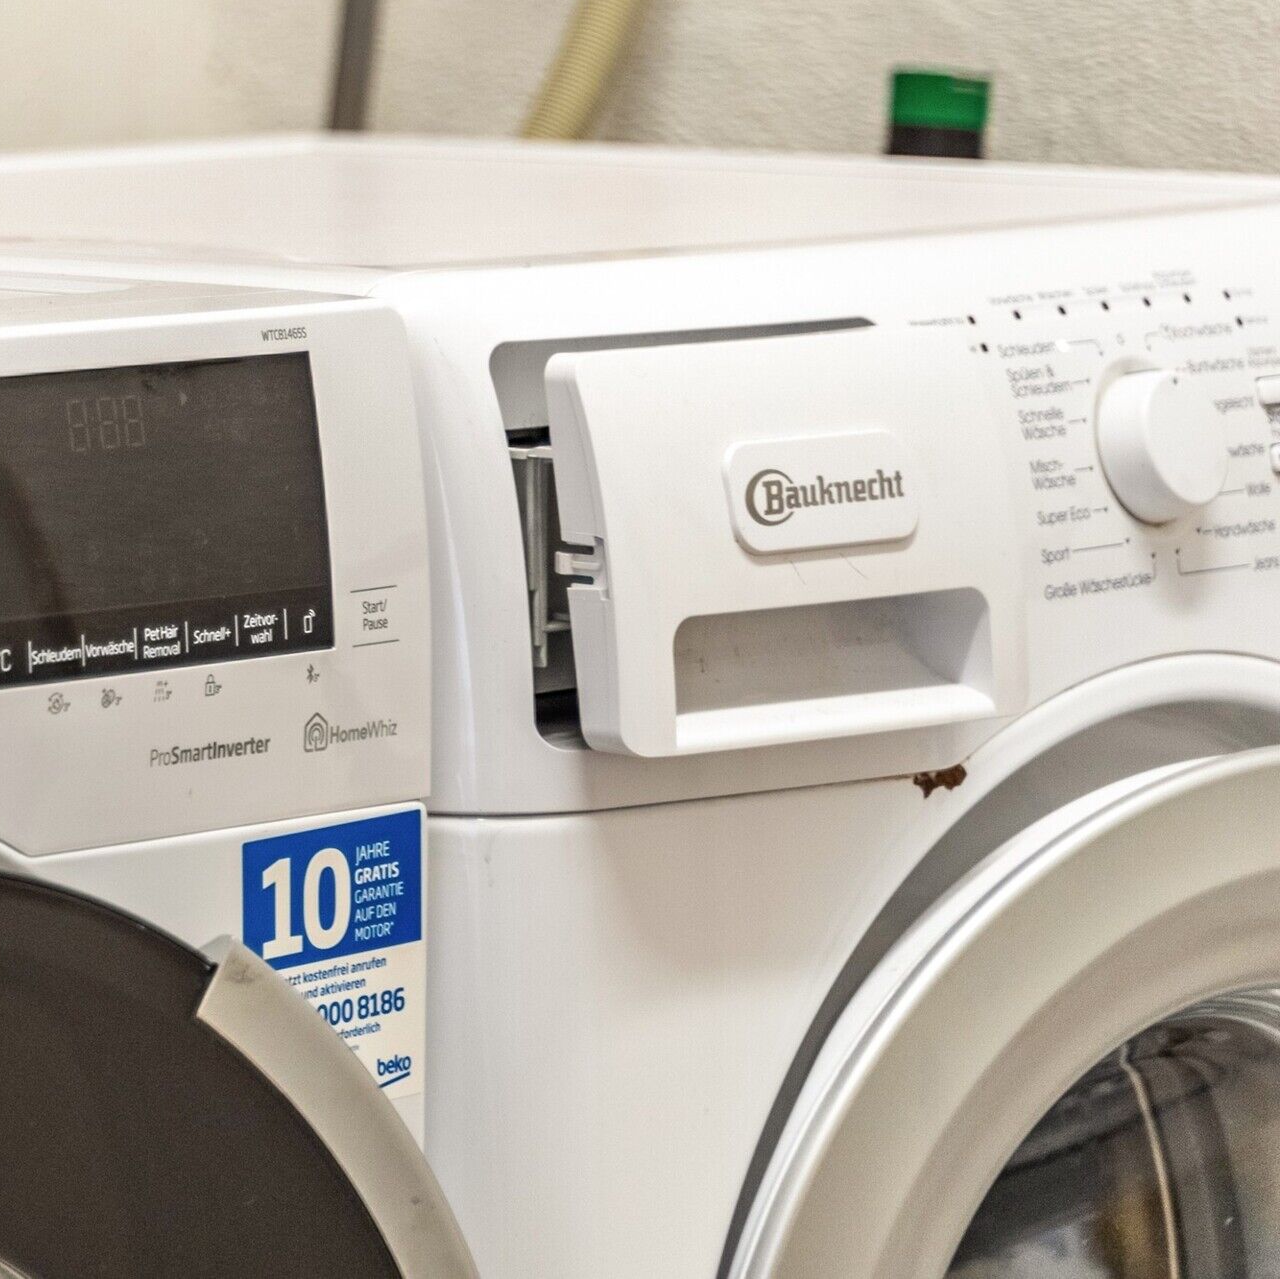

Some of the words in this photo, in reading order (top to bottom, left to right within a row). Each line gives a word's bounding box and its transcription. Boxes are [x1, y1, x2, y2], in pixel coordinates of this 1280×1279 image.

[758, 469, 905, 517] Bauknecht
[362, 598, 388, 615] Start/
[244, 613, 279, 630] Zeitvor-
[363, 618, 389, 631] Pause
[144, 627, 161, 642] Pet
[161, 624, 179, 640] Hair
[193, 627, 233, 645] Schnell+
[251, 627, 274, 645] wahl
[32, 646, 82, 666] Schleudern
[85, 638, 135, 658] Vorwäsche
[143, 640, 182, 660] Removal
[329, 720, 399, 745] HomeWhiz
[149, 736, 271, 768] ProSmartInverter
[355, 840, 390, 866] JAHRE
[354, 861, 400, 885] GRATIS
[354, 881, 404, 904] GARANTIE
[262, 847, 351, 961] 10
[354, 905, 376, 923] AUF
[376, 901, 397, 919] DEN
[302, 962, 349, 984] kostenfrei
[350, 957, 387, 974] anrufen
[320, 978, 366, 998] aktivieren
[357, 986, 406, 1020] 8186
[376, 1054, 412, 1077] beko
